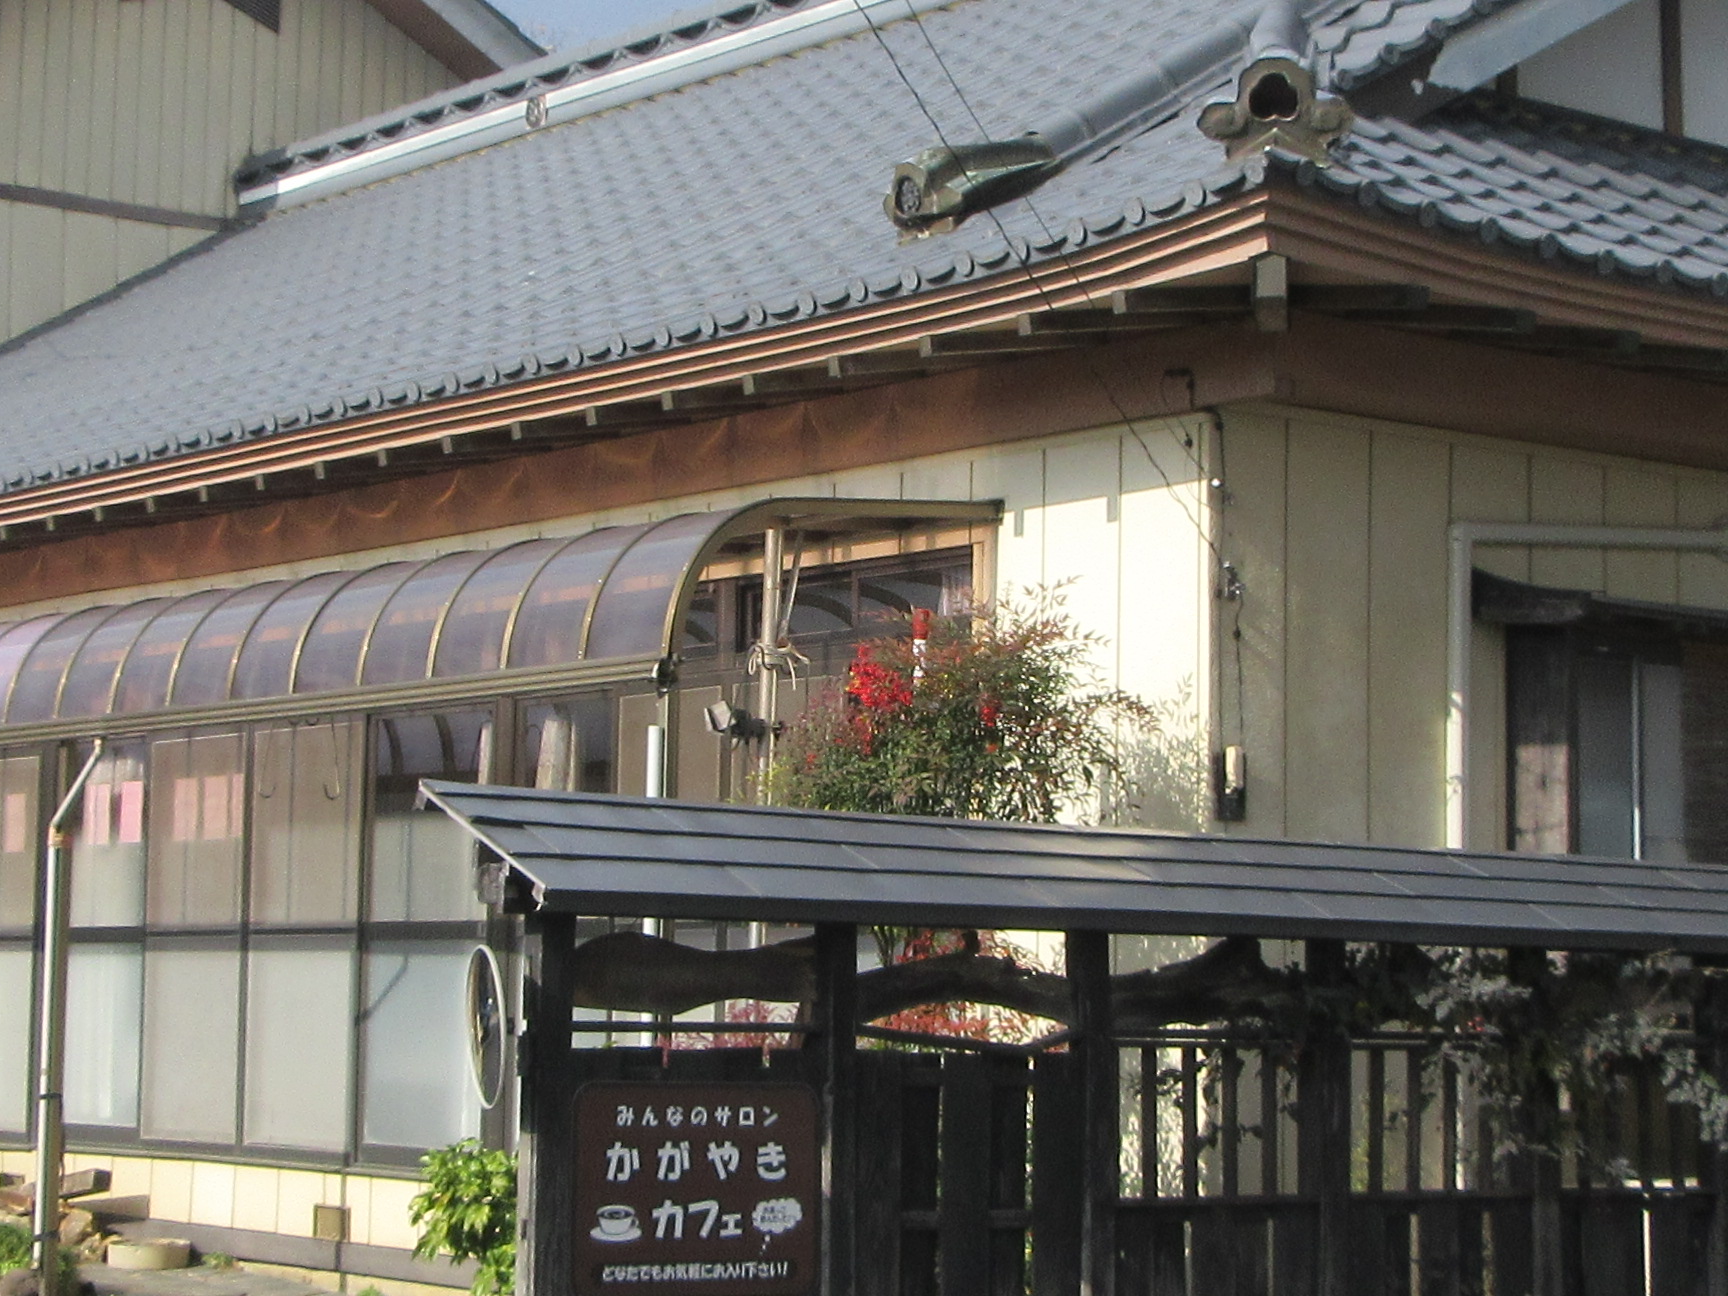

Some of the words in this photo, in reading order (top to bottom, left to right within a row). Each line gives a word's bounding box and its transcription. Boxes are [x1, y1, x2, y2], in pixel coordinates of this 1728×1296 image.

[616, 1105, 778, 1126] みんなのサロン
[606, 1141, 787, 1181] かがやき
[652, 1199, 743, 1238] カフェ
